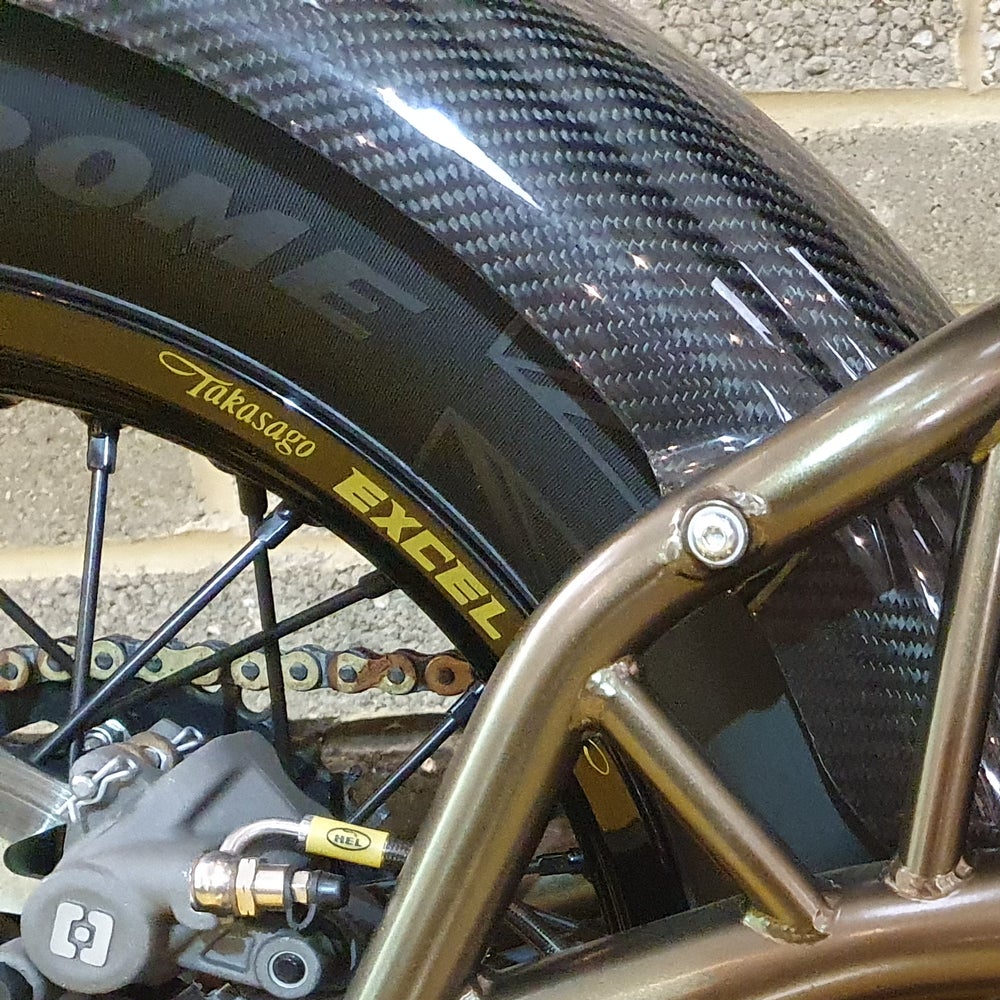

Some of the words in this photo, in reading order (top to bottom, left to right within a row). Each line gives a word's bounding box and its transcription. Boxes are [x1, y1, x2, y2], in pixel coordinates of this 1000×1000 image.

[157, 349, 317, 459] Takasago
[332, 466, 507, 641] EXCEL
[334, 834, 363, 847] HEL
